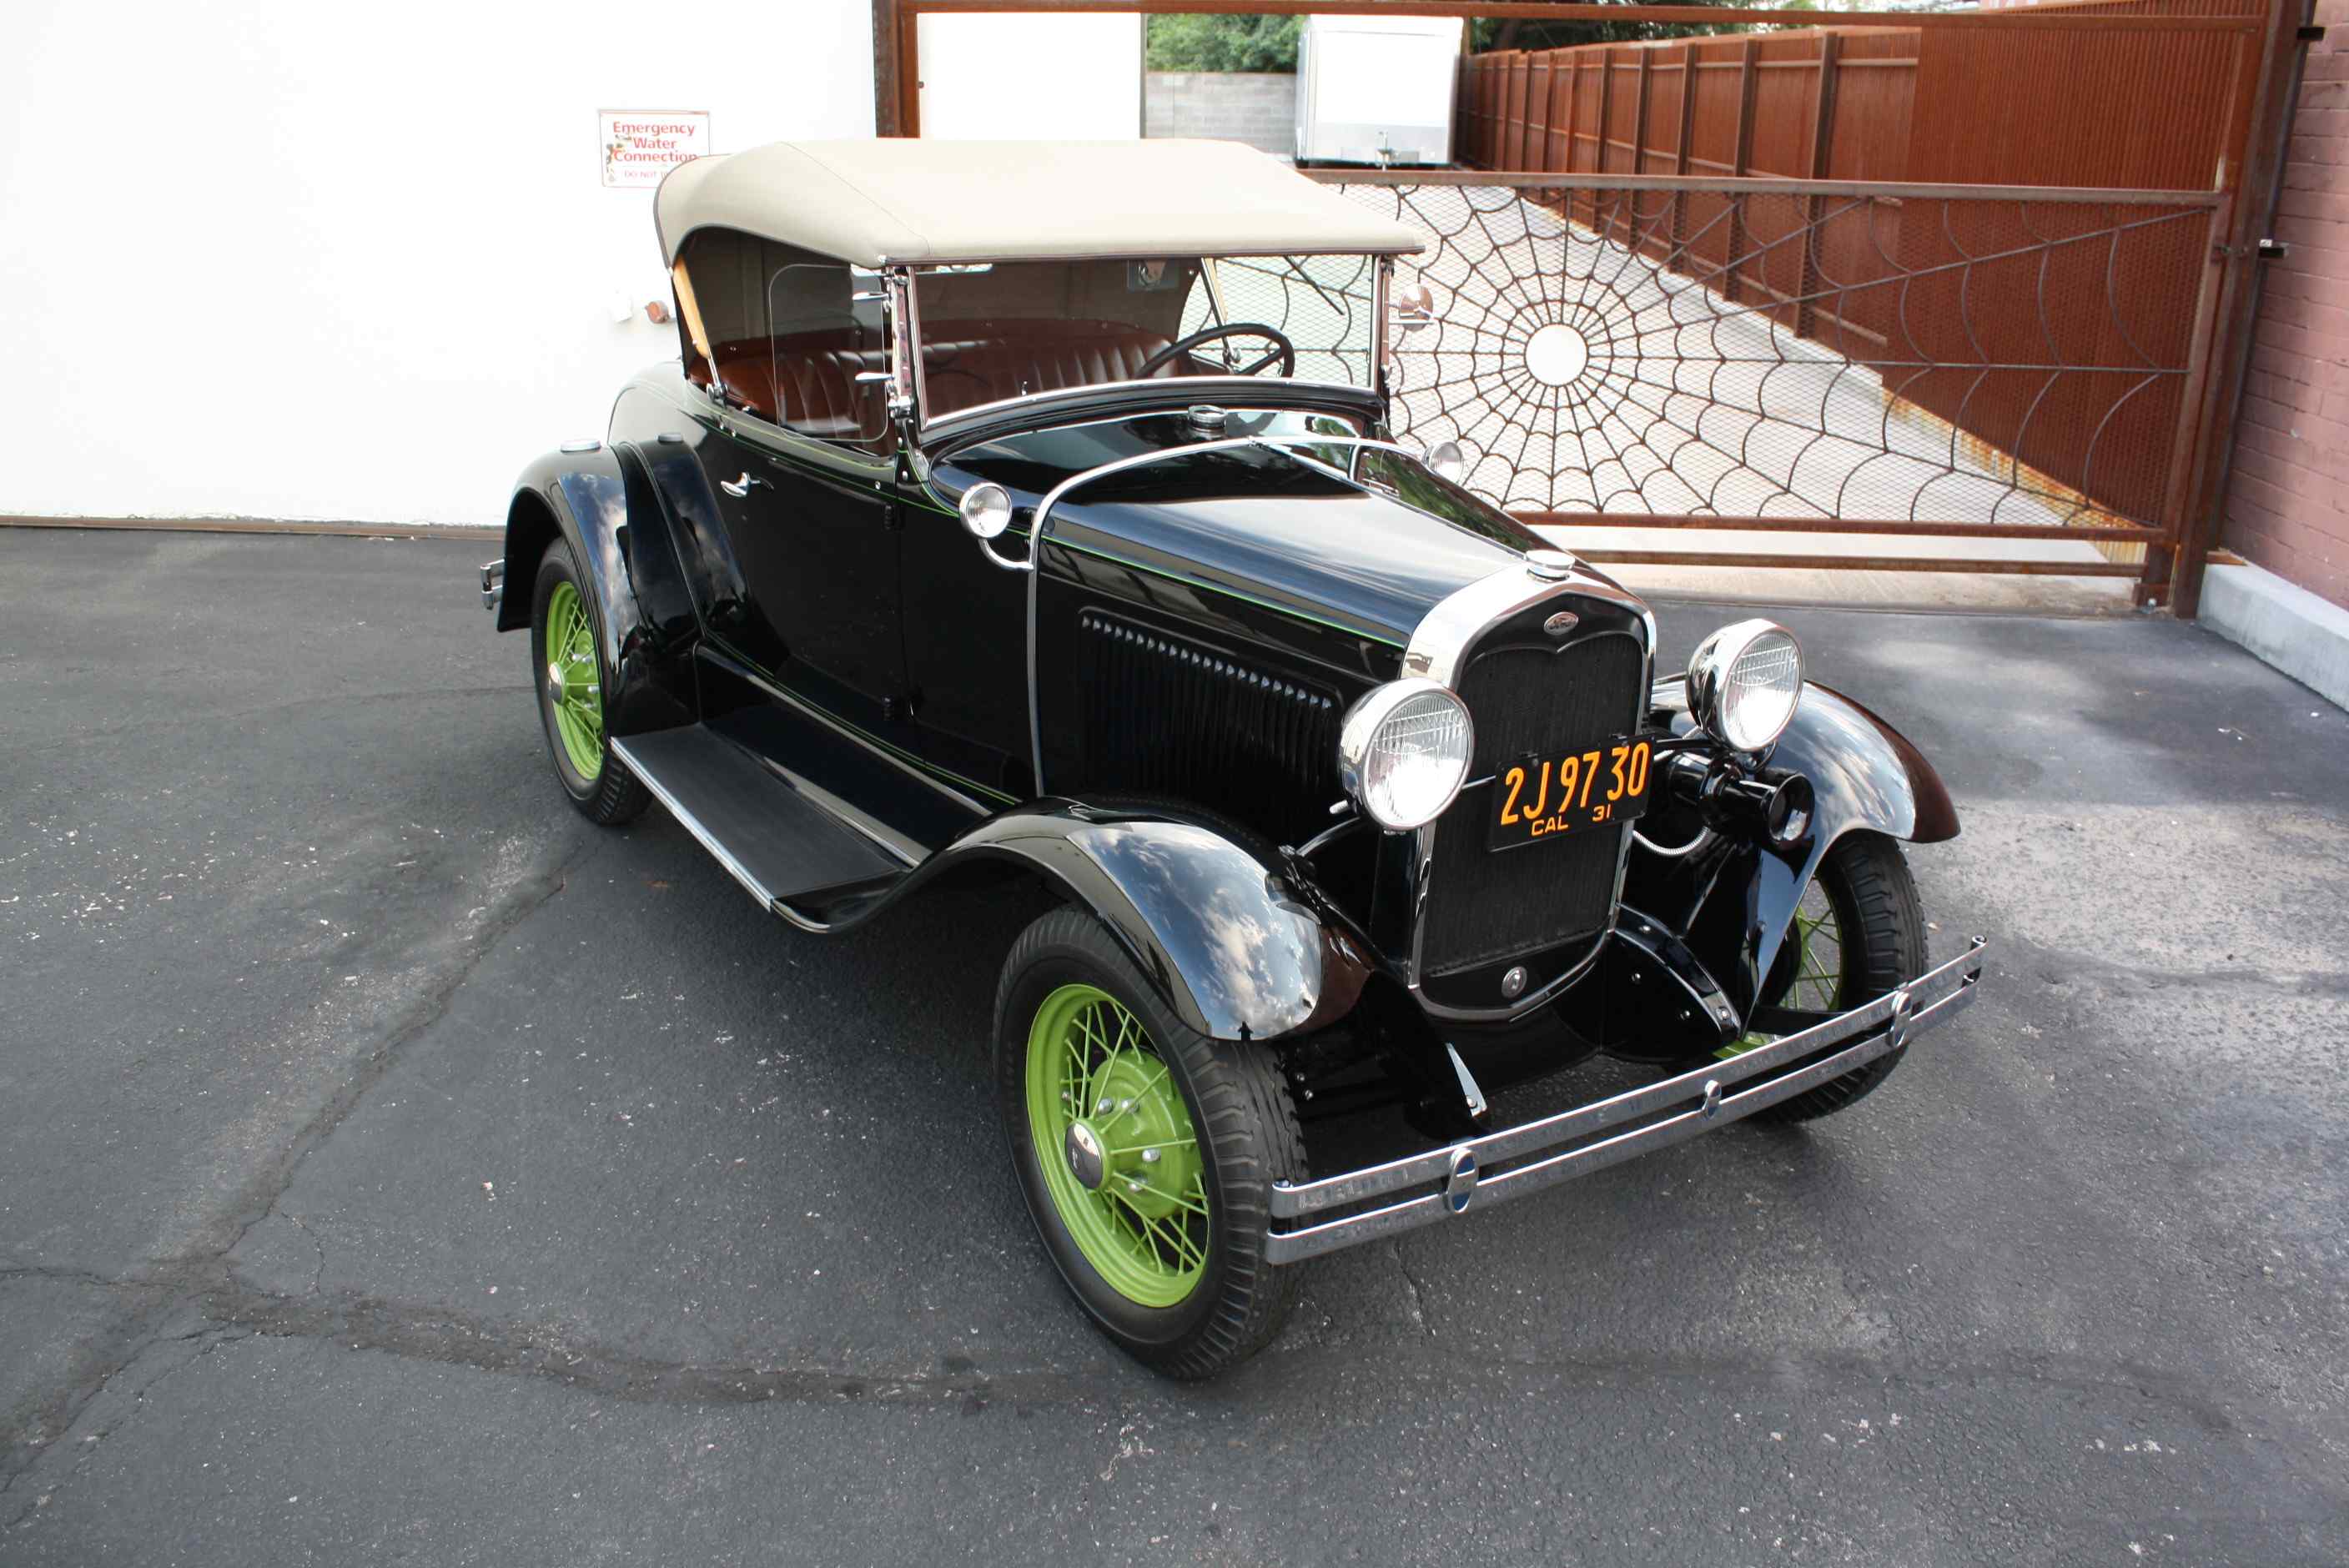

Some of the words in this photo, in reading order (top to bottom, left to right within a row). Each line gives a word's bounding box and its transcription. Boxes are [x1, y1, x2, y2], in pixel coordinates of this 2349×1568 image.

[612, 121, 695, 136] Emergency
[632, 137, 677, 149] Water
[613, 150, 697, 162] Connection
[1592, 803, 1612, 822] 31
[1532, 816, 1569, 837] CAL
